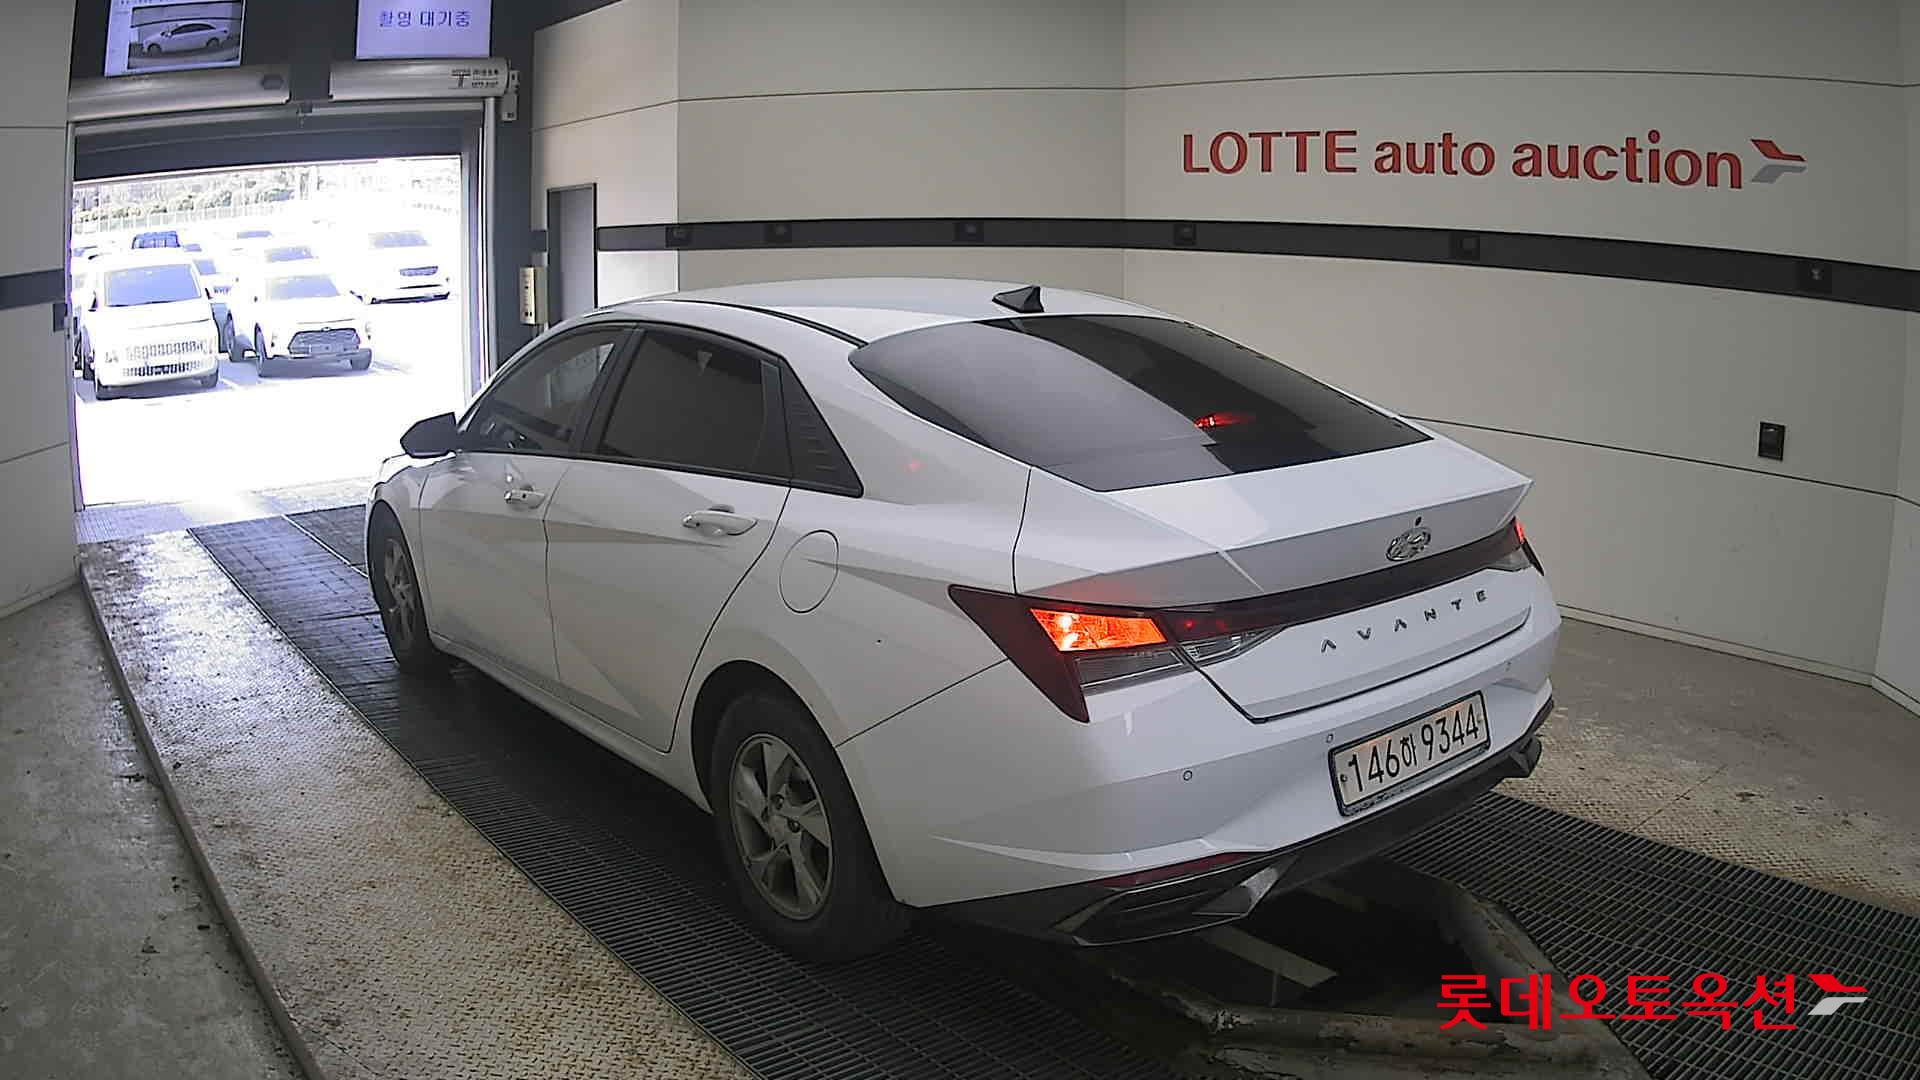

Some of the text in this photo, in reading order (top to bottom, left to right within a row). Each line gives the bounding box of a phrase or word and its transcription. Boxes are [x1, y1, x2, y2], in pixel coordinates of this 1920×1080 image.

[420, 11, 470, 27] 대기중
[1184, 130, 1742, 188] LOTTE auto auction
[1321, 590, 1487, 653] AVANTE
[1421, 703, 1479, 761] 9344
